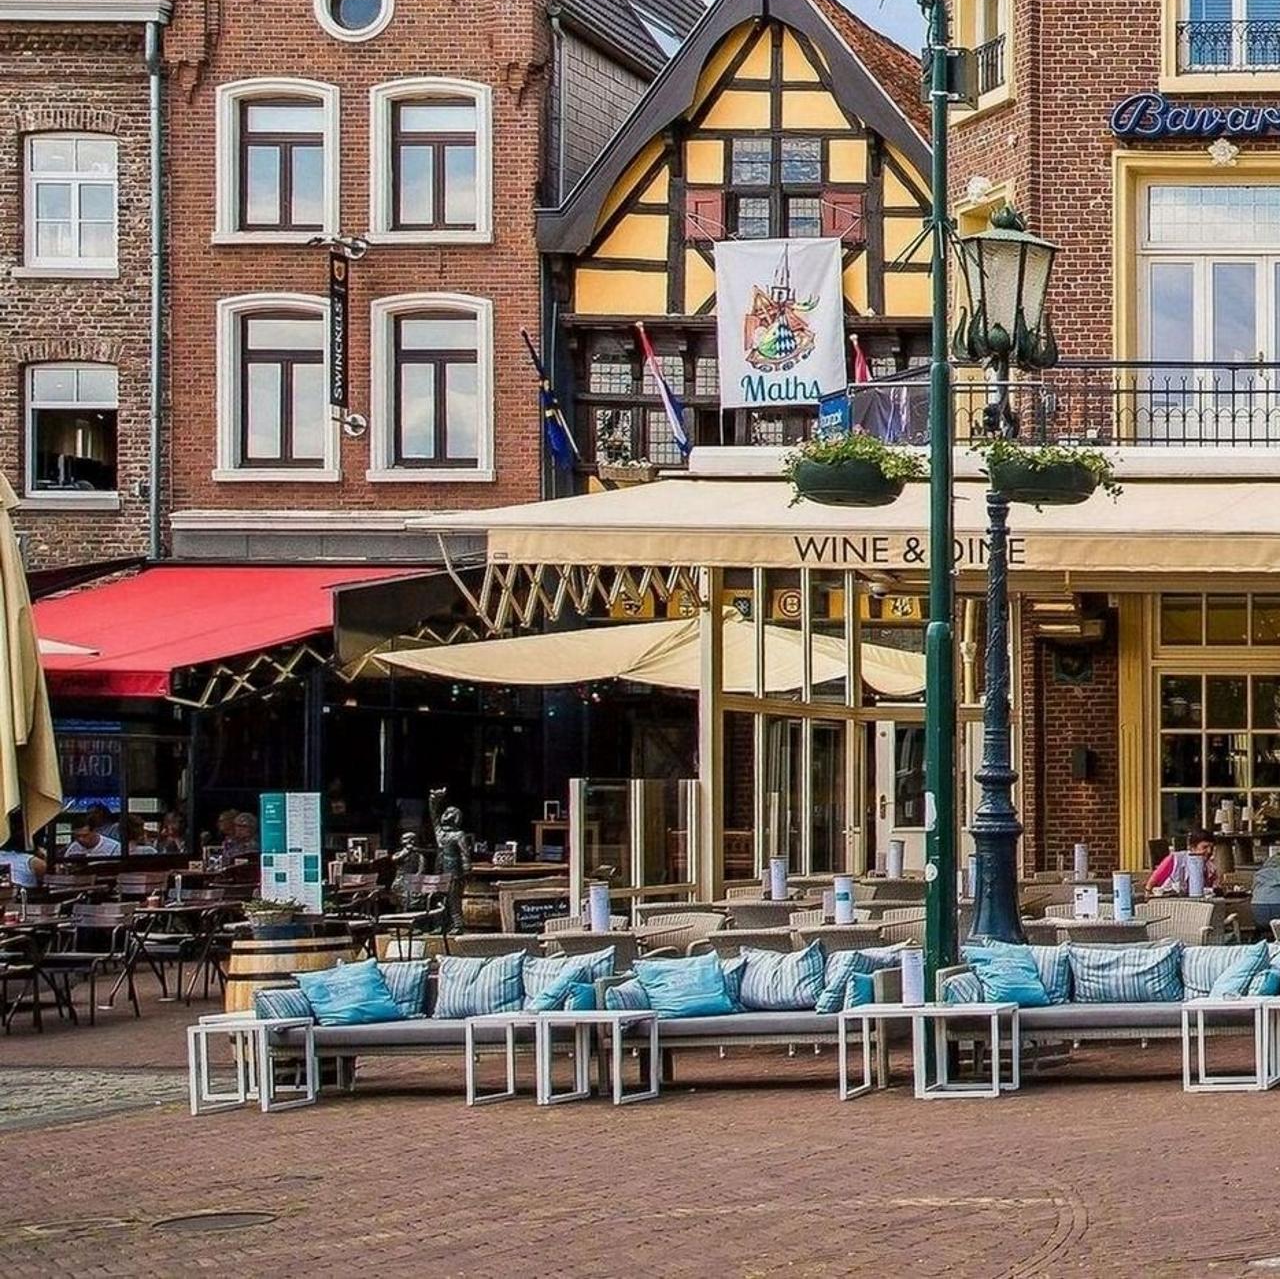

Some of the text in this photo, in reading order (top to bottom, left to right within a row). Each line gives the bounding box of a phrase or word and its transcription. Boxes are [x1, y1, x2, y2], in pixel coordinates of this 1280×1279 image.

[741, 374, 822, 402] Maths
[794, 536, 889, 563] WINE
[903, 536, 925, 564] &
